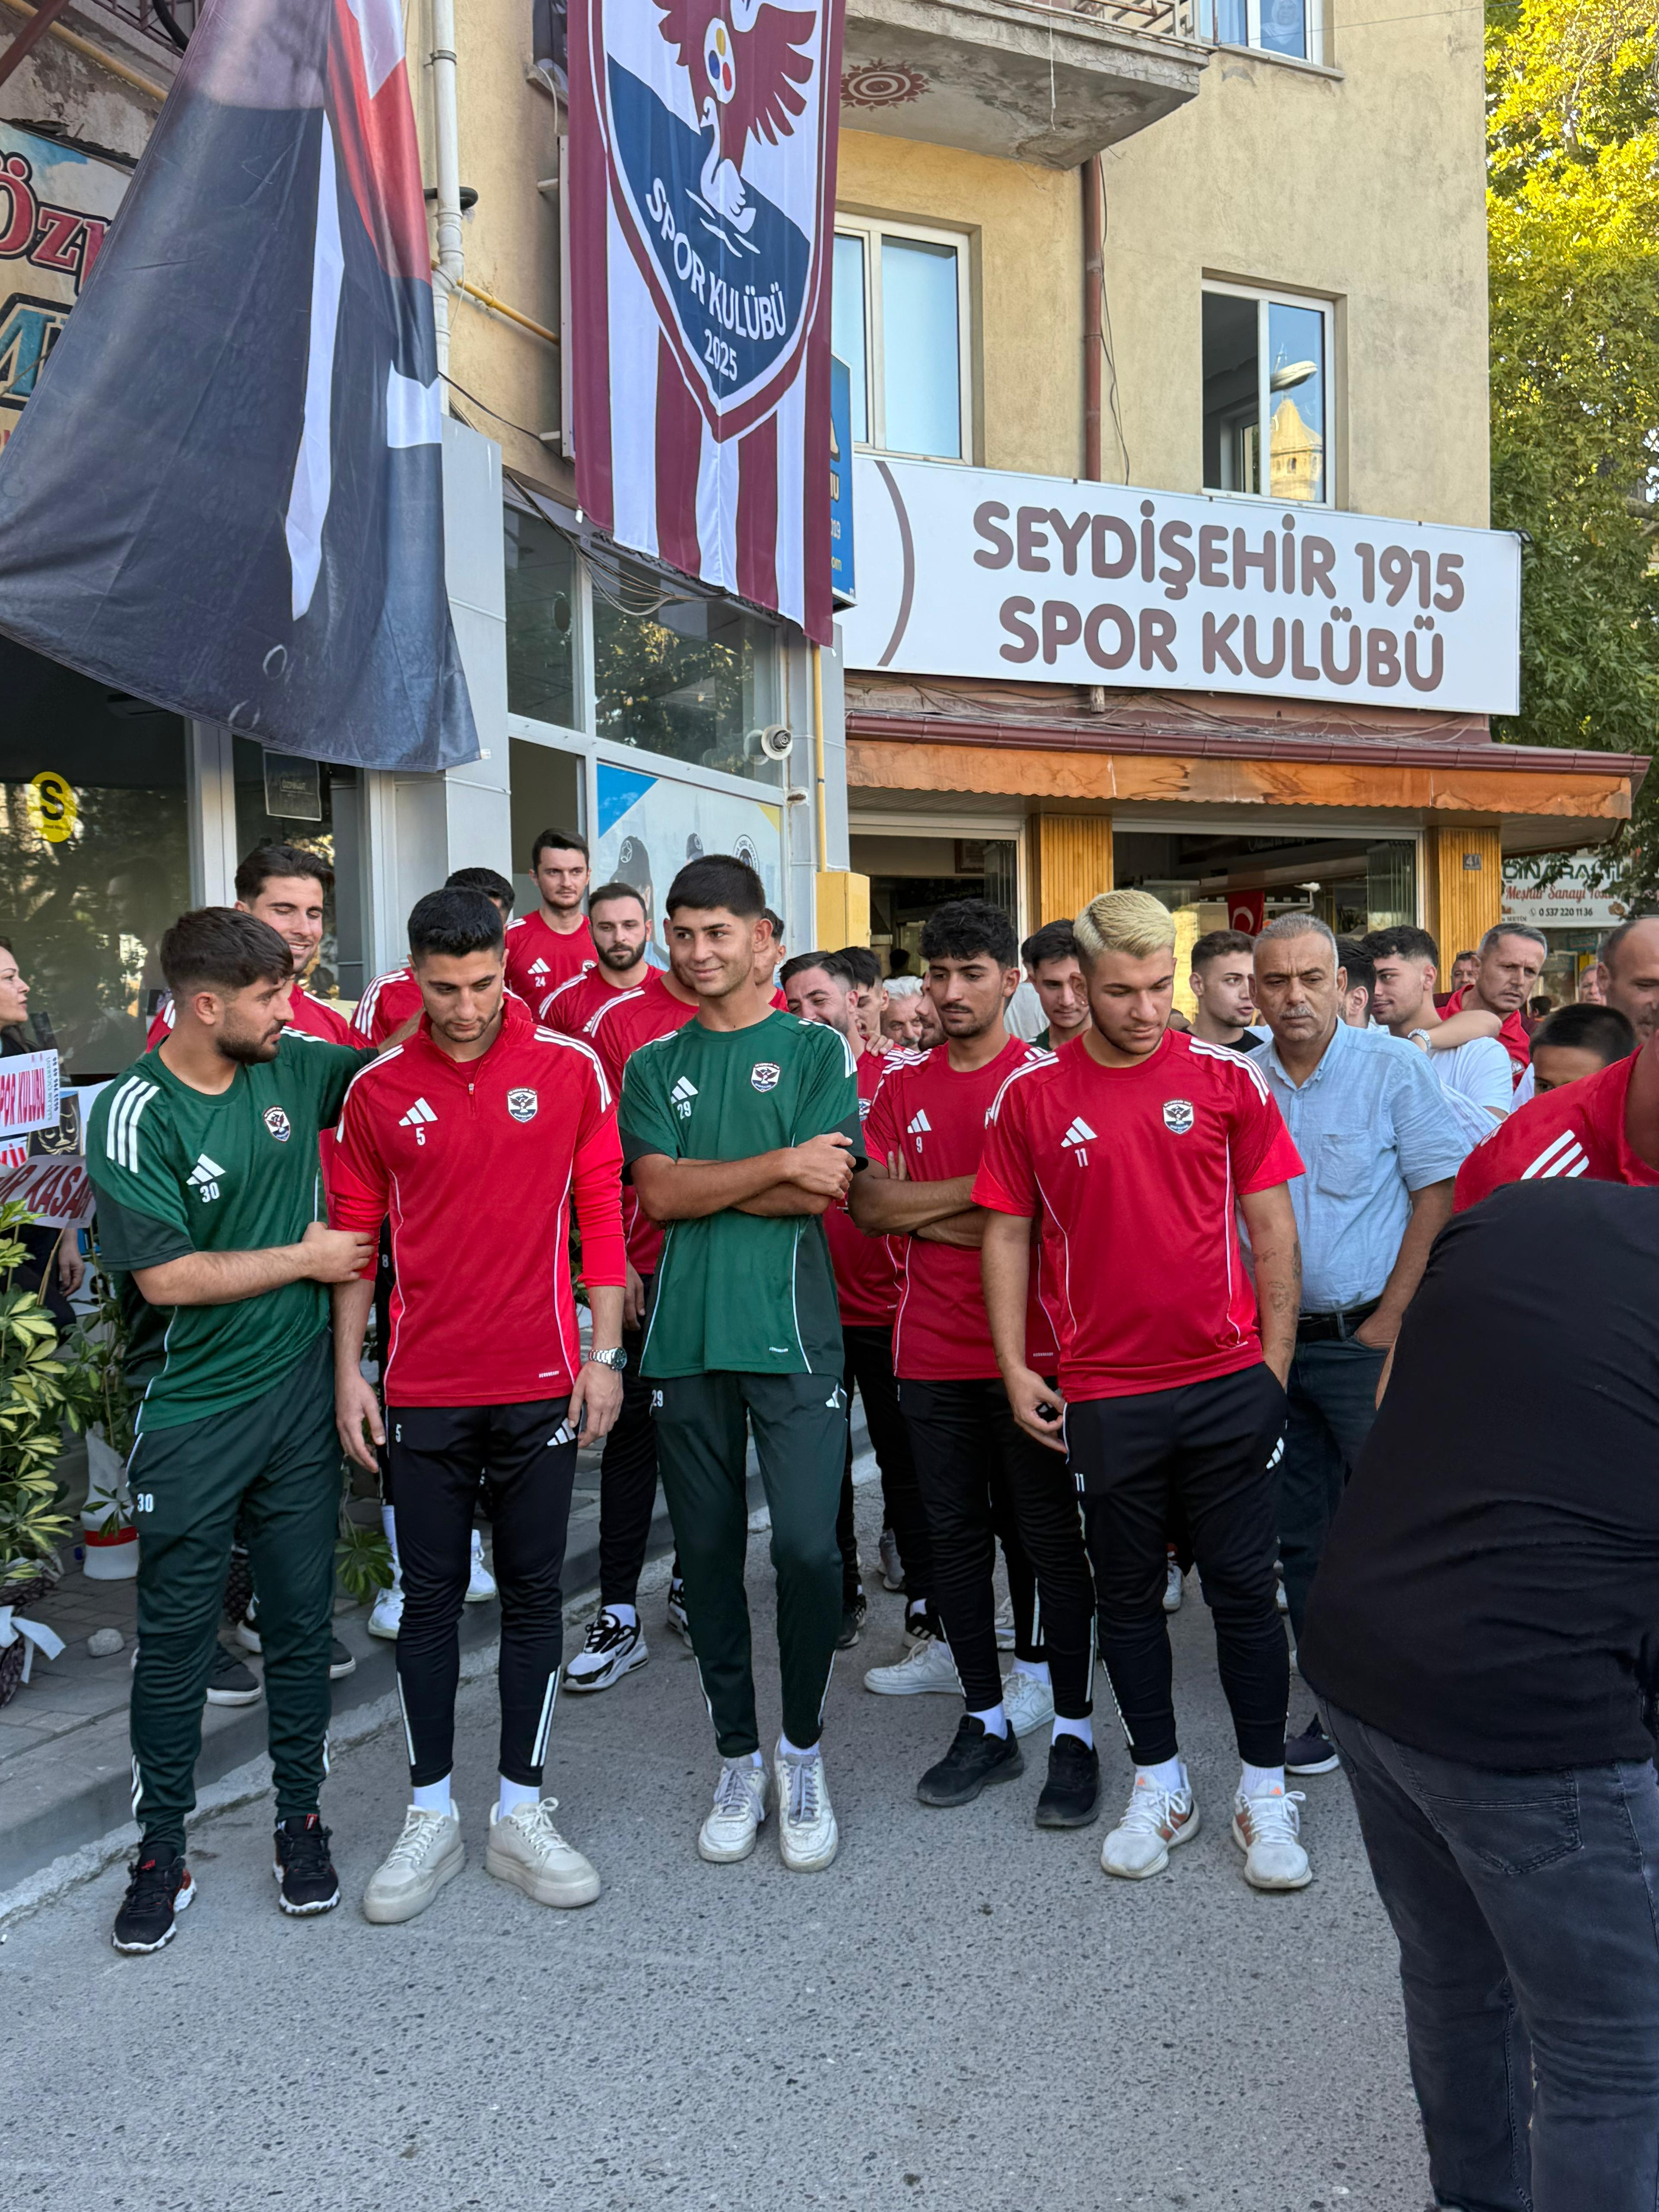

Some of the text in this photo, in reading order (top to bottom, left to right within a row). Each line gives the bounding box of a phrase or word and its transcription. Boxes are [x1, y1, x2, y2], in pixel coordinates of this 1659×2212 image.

[646, 178, 786, 340] SPOR KULÜBÜ
[704, 329, 737, 381] 2025
[973, 499, 1464, 612] SEYDİŞEHİR 1915
[999, 596, 1444, 692] SPOR KULÜBÜ
[1560, 908, 1574, 916] 220
[1583, 908, 1593, 916] 36
[535, 976, 546, 987] 24
[677, 1100, 692, 1120] 29
[416, 1127, 426, 1146] 5
[916, 1136, 923, 1154] 9
[1074, 1147, 1089, 1167] 11
[200, 1182, 220, 1203] 30
[1074, 1472, 1085, 1492] 11
[137, 1493, 154, 1512] 30
